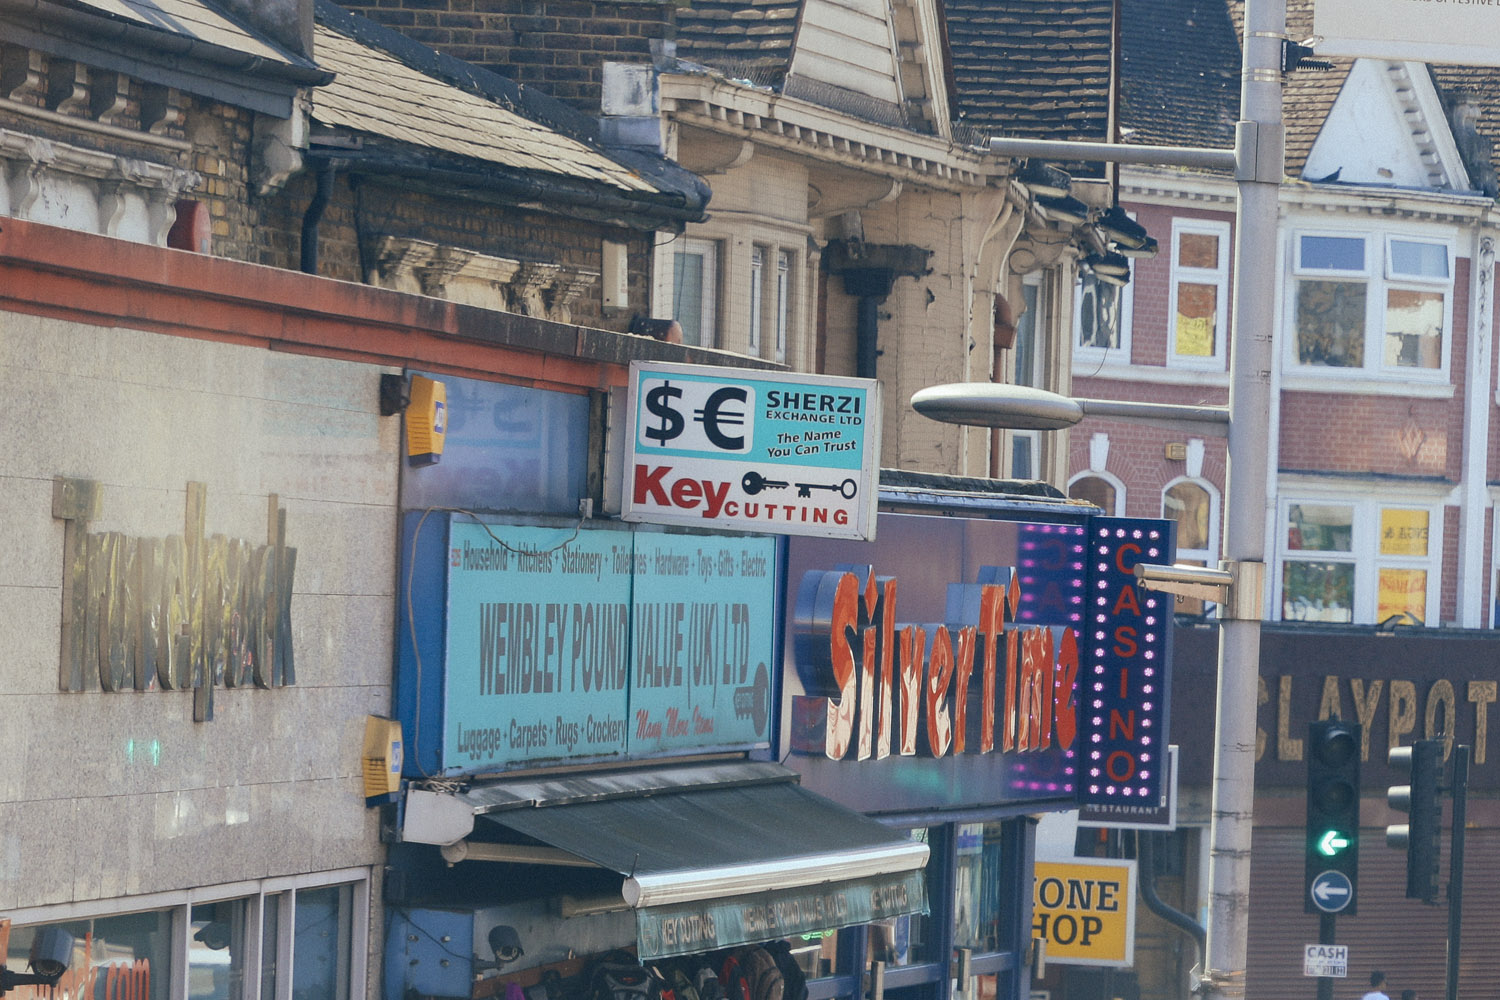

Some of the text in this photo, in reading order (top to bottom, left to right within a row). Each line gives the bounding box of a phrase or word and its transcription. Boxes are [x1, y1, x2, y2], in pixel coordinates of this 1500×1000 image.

[766, 390, 861, 414] SHERZI
[766, 410, 862, 426] EXCHANGE LTD
[767, 439, 857, 458] You Can Trust
[777, 429, 842, 444] The Name
[633, 464, 732, 519] Key
[724, 501, 848, 525] CUTTING
[463, 539, 508, 571] Household
[561, 543, 602, 582] Stationery
[655, 547, 689, 576] Hardware
[697, 548, 713, 584] Toys
[718, 549, 734, 577] Gifts
[741, 550, 766, 577] Electric
[479, 601, 750, 710] WEMBLEY POUND VALUE (UK) LTD
[1105, 542, 1142, 783] CASINO
[457, 713, 627, 760] Luggage Carpets Rugs Crockery
[1034, 877, 1119, 911] ONE
[1307, 946, 1345, 960] CASH
